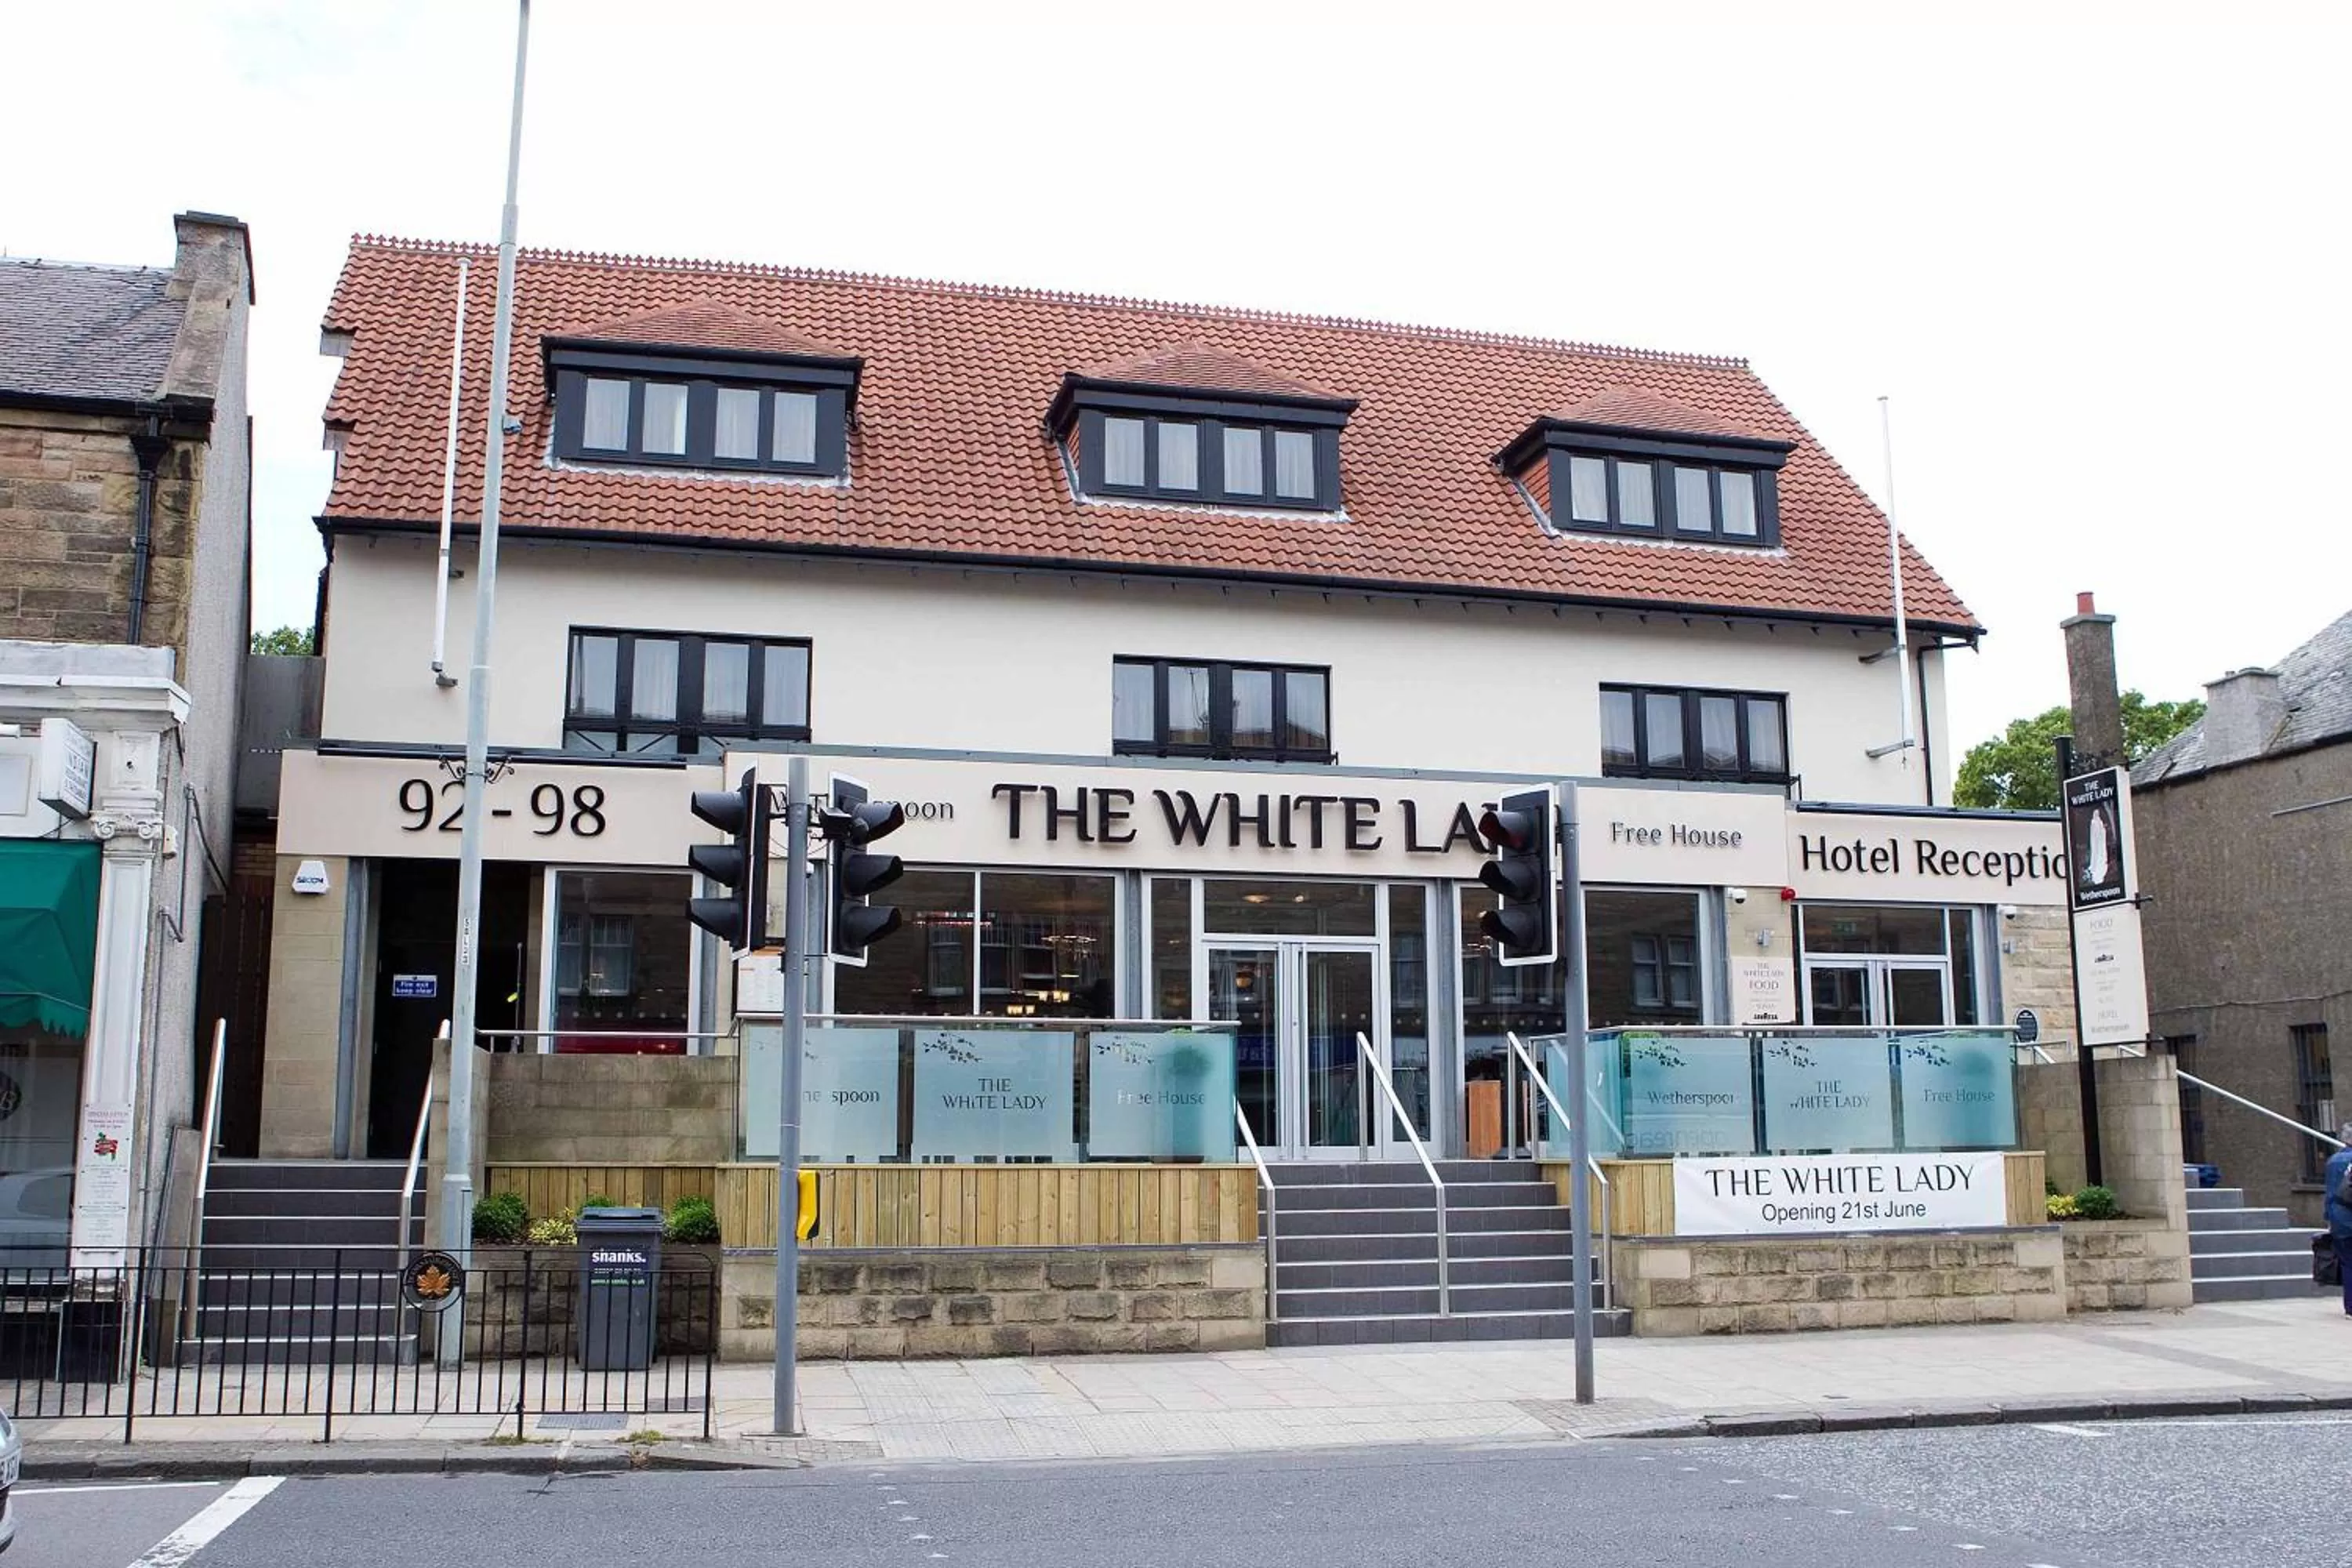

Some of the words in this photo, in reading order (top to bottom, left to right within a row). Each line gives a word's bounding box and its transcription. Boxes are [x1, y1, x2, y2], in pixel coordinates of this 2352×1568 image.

[2083, 780, 2099, 791] THE
[2071, 792, 2094, 806] WHITE
[2095, 786, 2114, 800] LADY
[531, 783, 606, 837] 98
[990, 783, 1137, 844] THE
[1152, 789, 1383, 850] WHITE
[1397, 799, 1499, 854] LA
[1611, 822, 1662, 844] Free
[1669, 823, 1742, 848] House
[1798, 834, 1900, 873] Hotel
[1914, 839, 2067, 887] Receptio
[978, 1078, 1011, 1092] THE
[1816, 1080, 1842, 1094] THE
[942, 1094, 996, 1110] WHITE
[1003, 1094, 1048, 1109] LADY
[1158, 1091, 1206, 1105] House
[1835, 1094, 1871, 1108] LADY
[1923, 1089, 1952, 1102] Free
[1956, 1089, 1995, 1102] House
[1705, 1169, 1772, 1196] THE
[1781, 1166, 1885, 1195] WHITE
[1895, 1164, 1974, 1192] LADY
[1762, 1203, 1836, 1225] Opening
[1842, 1202, 1880, 1219] 21st
[1884, 1201, 1927, 1218] June
